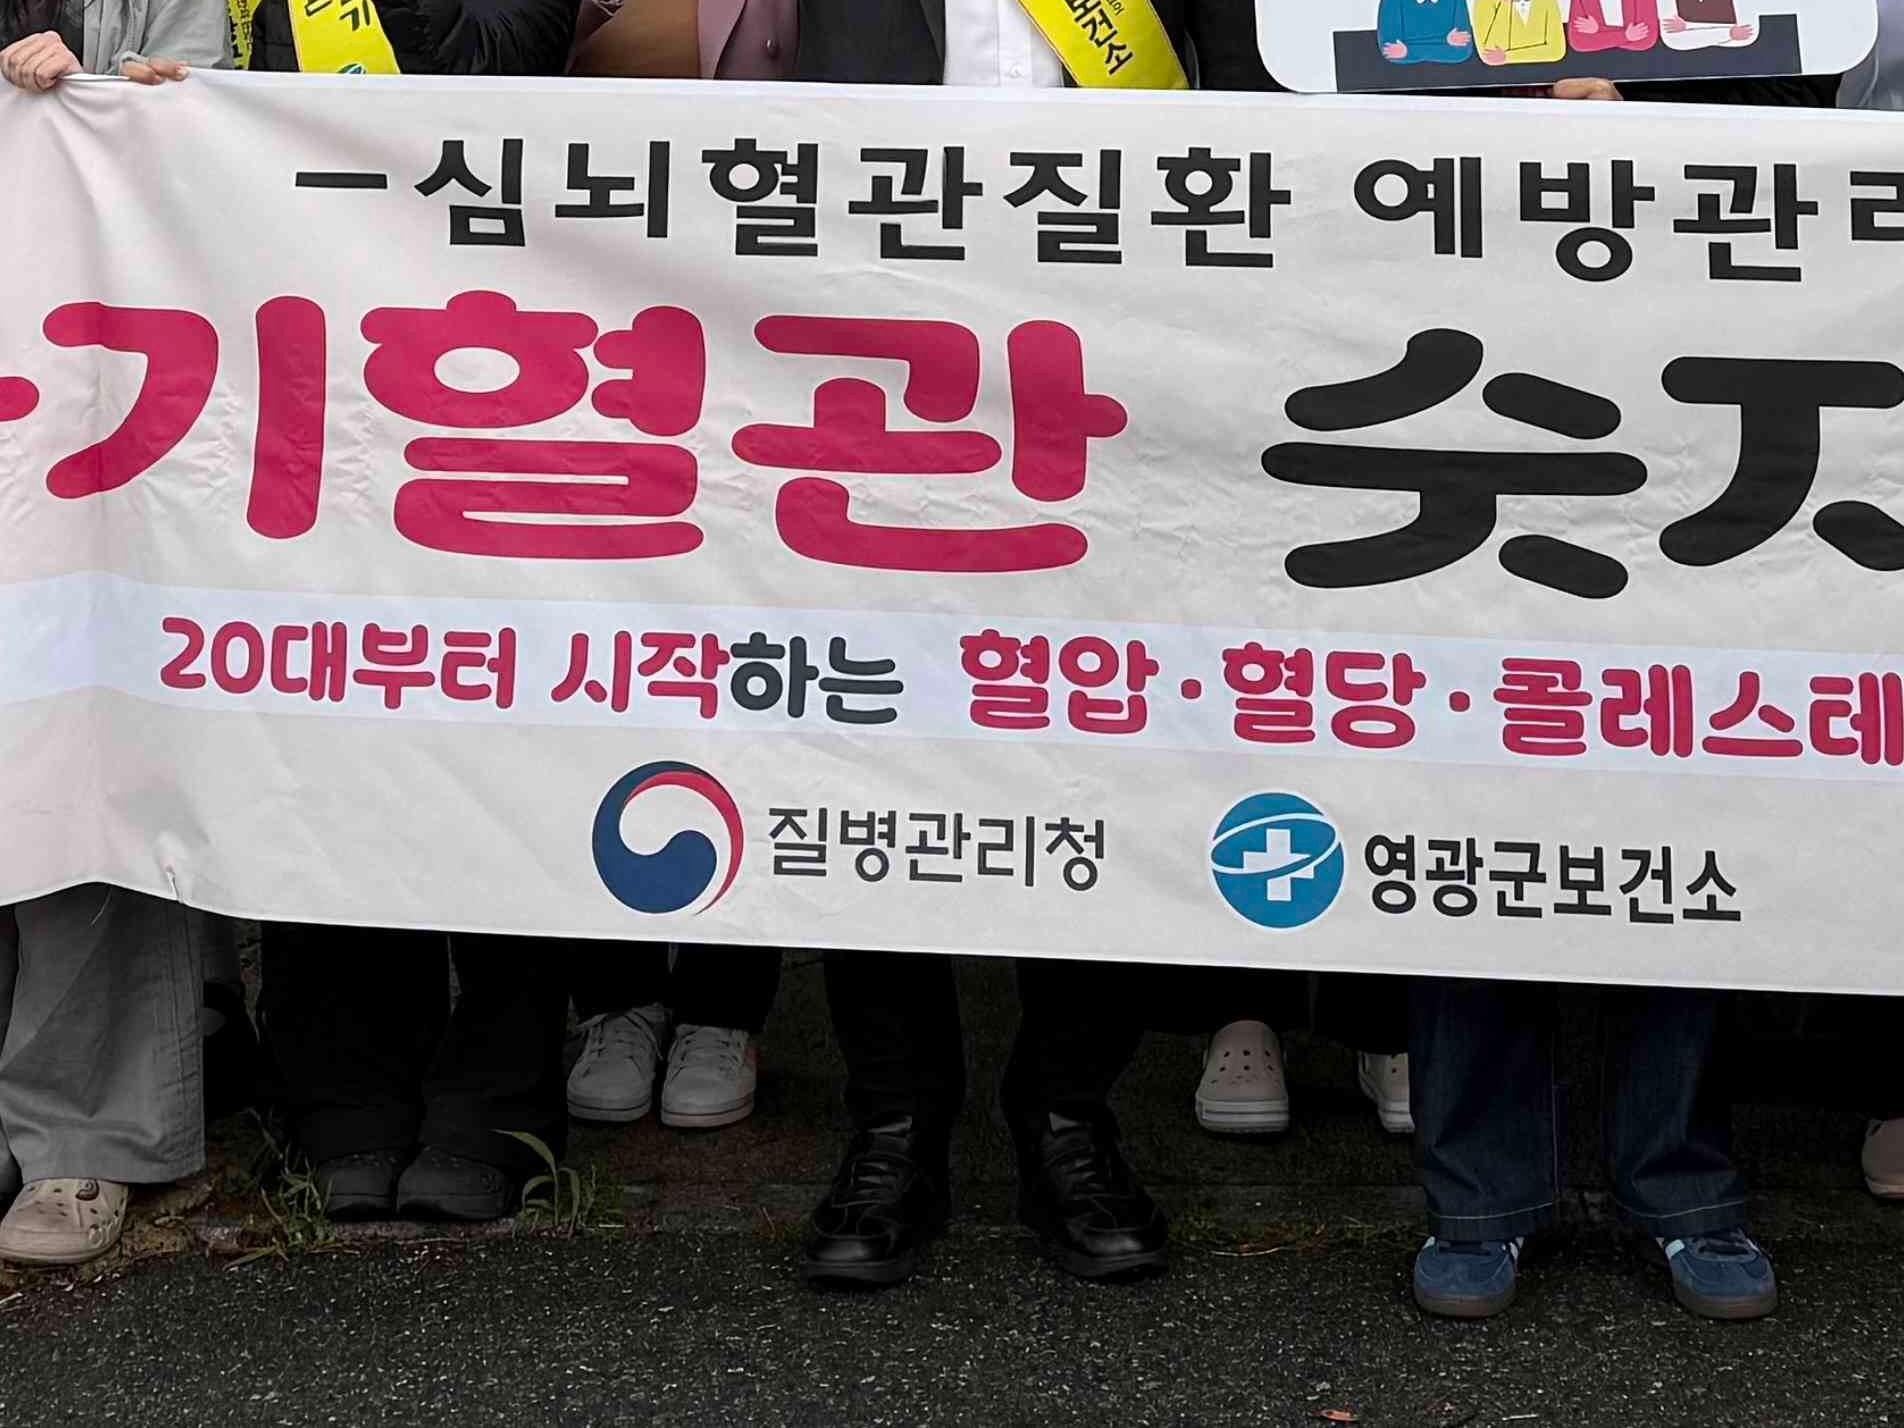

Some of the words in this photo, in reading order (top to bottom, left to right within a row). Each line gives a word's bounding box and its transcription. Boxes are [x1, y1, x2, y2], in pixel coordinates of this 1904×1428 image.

[160, 616, 518, 712] 20대부터
[549, 628, 904, 726] 시작하는
[765, 804, 1109, 892] 질병관리청
[1361, 829, 1744, 924] 영광군보건소
